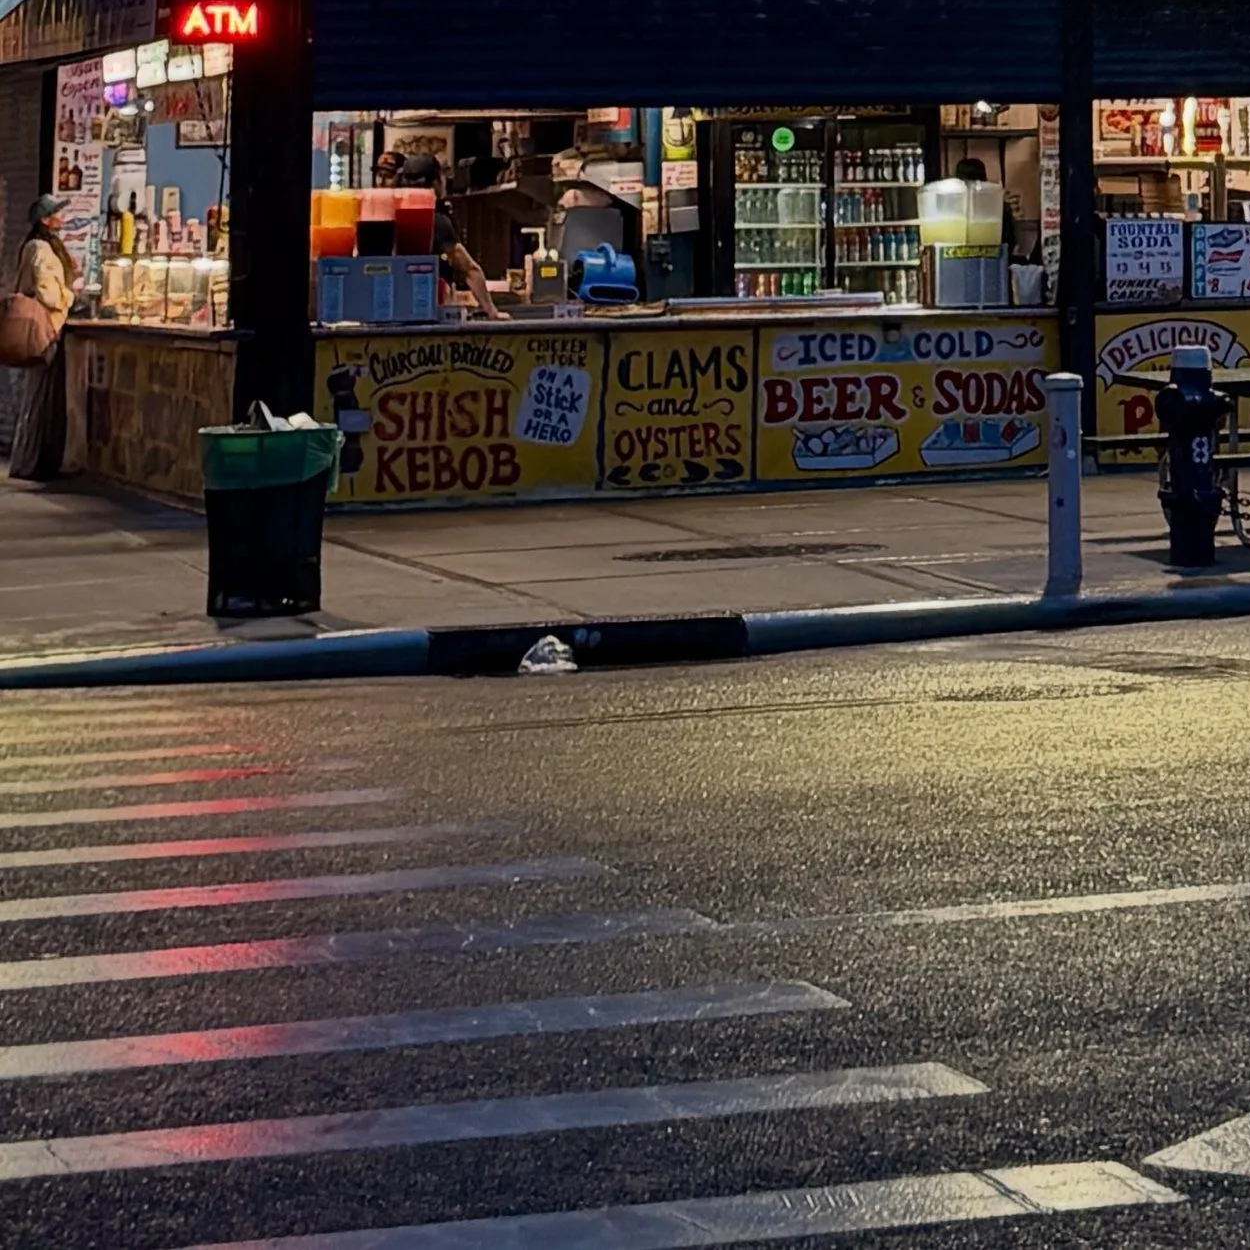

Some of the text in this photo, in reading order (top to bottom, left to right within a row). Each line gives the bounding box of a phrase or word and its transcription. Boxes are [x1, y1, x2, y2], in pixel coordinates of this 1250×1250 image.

[184, 5, 257, 35] ATM
[1110, 224, 1179, 236] FOUNTAIN
[1118, 236, 1173, 248] SODA
[1109, 278, 1160, 289] FUNNEL
[527, 338, 587, 352] CHICKEN
[798, 330, 994, 365] ICED COLD
[1108, 327, 1220, 369] DELICIOUS
[370, 342, 514, 385] CHARCOAL BROILED
[538, 369, 574, 388] ON A
[617, 345, 749, 392] CLAMS
[647, 388, 698, 417] and
[764, 369, 1048, 423] BEER & SODAS
[373, 389, 511, 442] SHISH
[533, 408, 569, 427] OR A
[523, 419, 572, 443] HERO
[614, 422, 744, 464] OYSTERS
[375, 445, 521, 494] KEBOB
